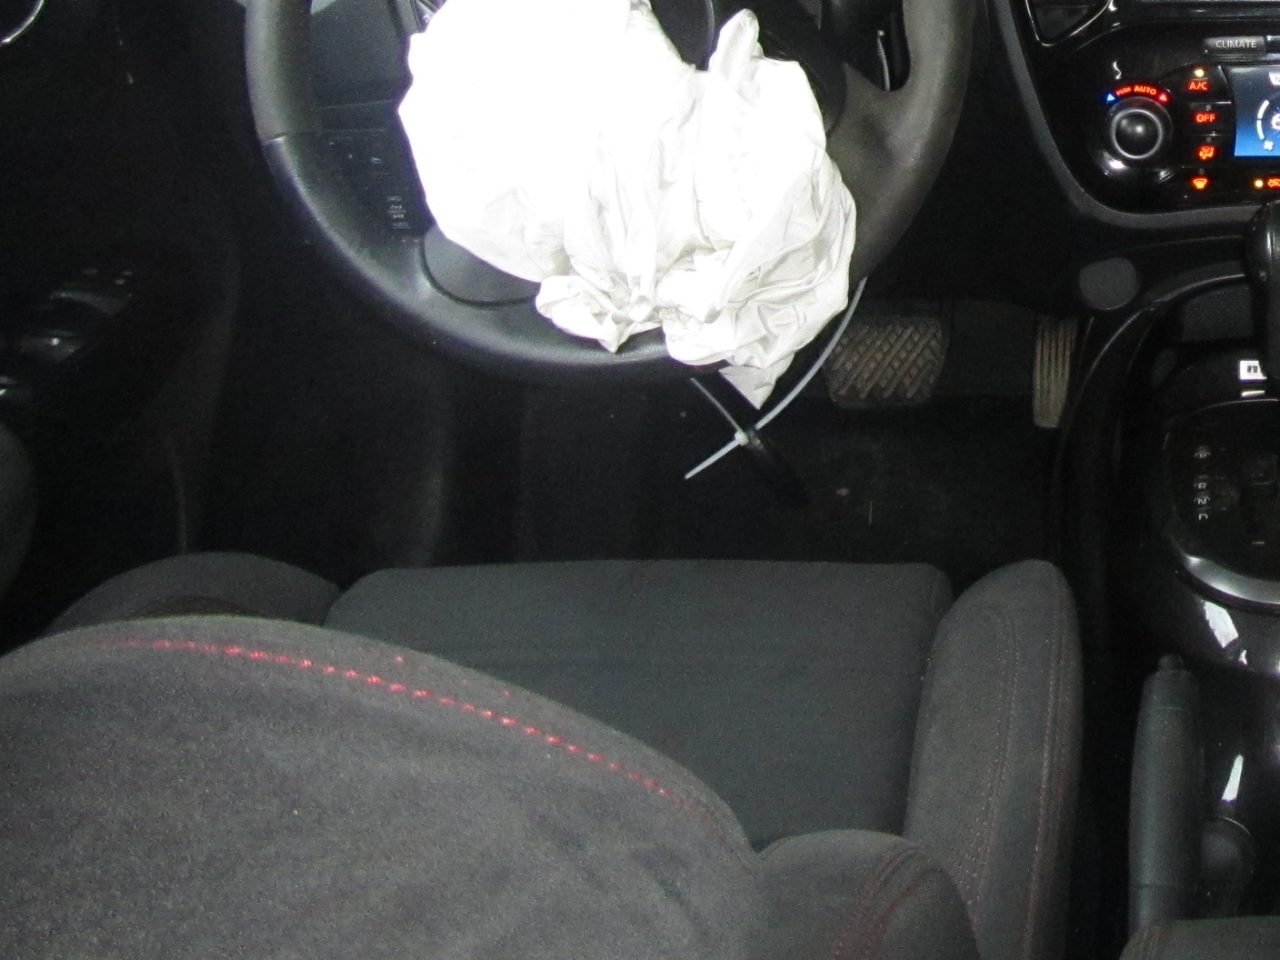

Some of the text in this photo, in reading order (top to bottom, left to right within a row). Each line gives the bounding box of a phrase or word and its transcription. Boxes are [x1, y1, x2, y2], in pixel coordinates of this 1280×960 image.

[1215, 39, 1257, 49] CLIMATE
[1189, 81, 1208, 90] A/C
[1133, 85, 1157, 96] AUTO
[1196, 114, 1216, 123] OFF
